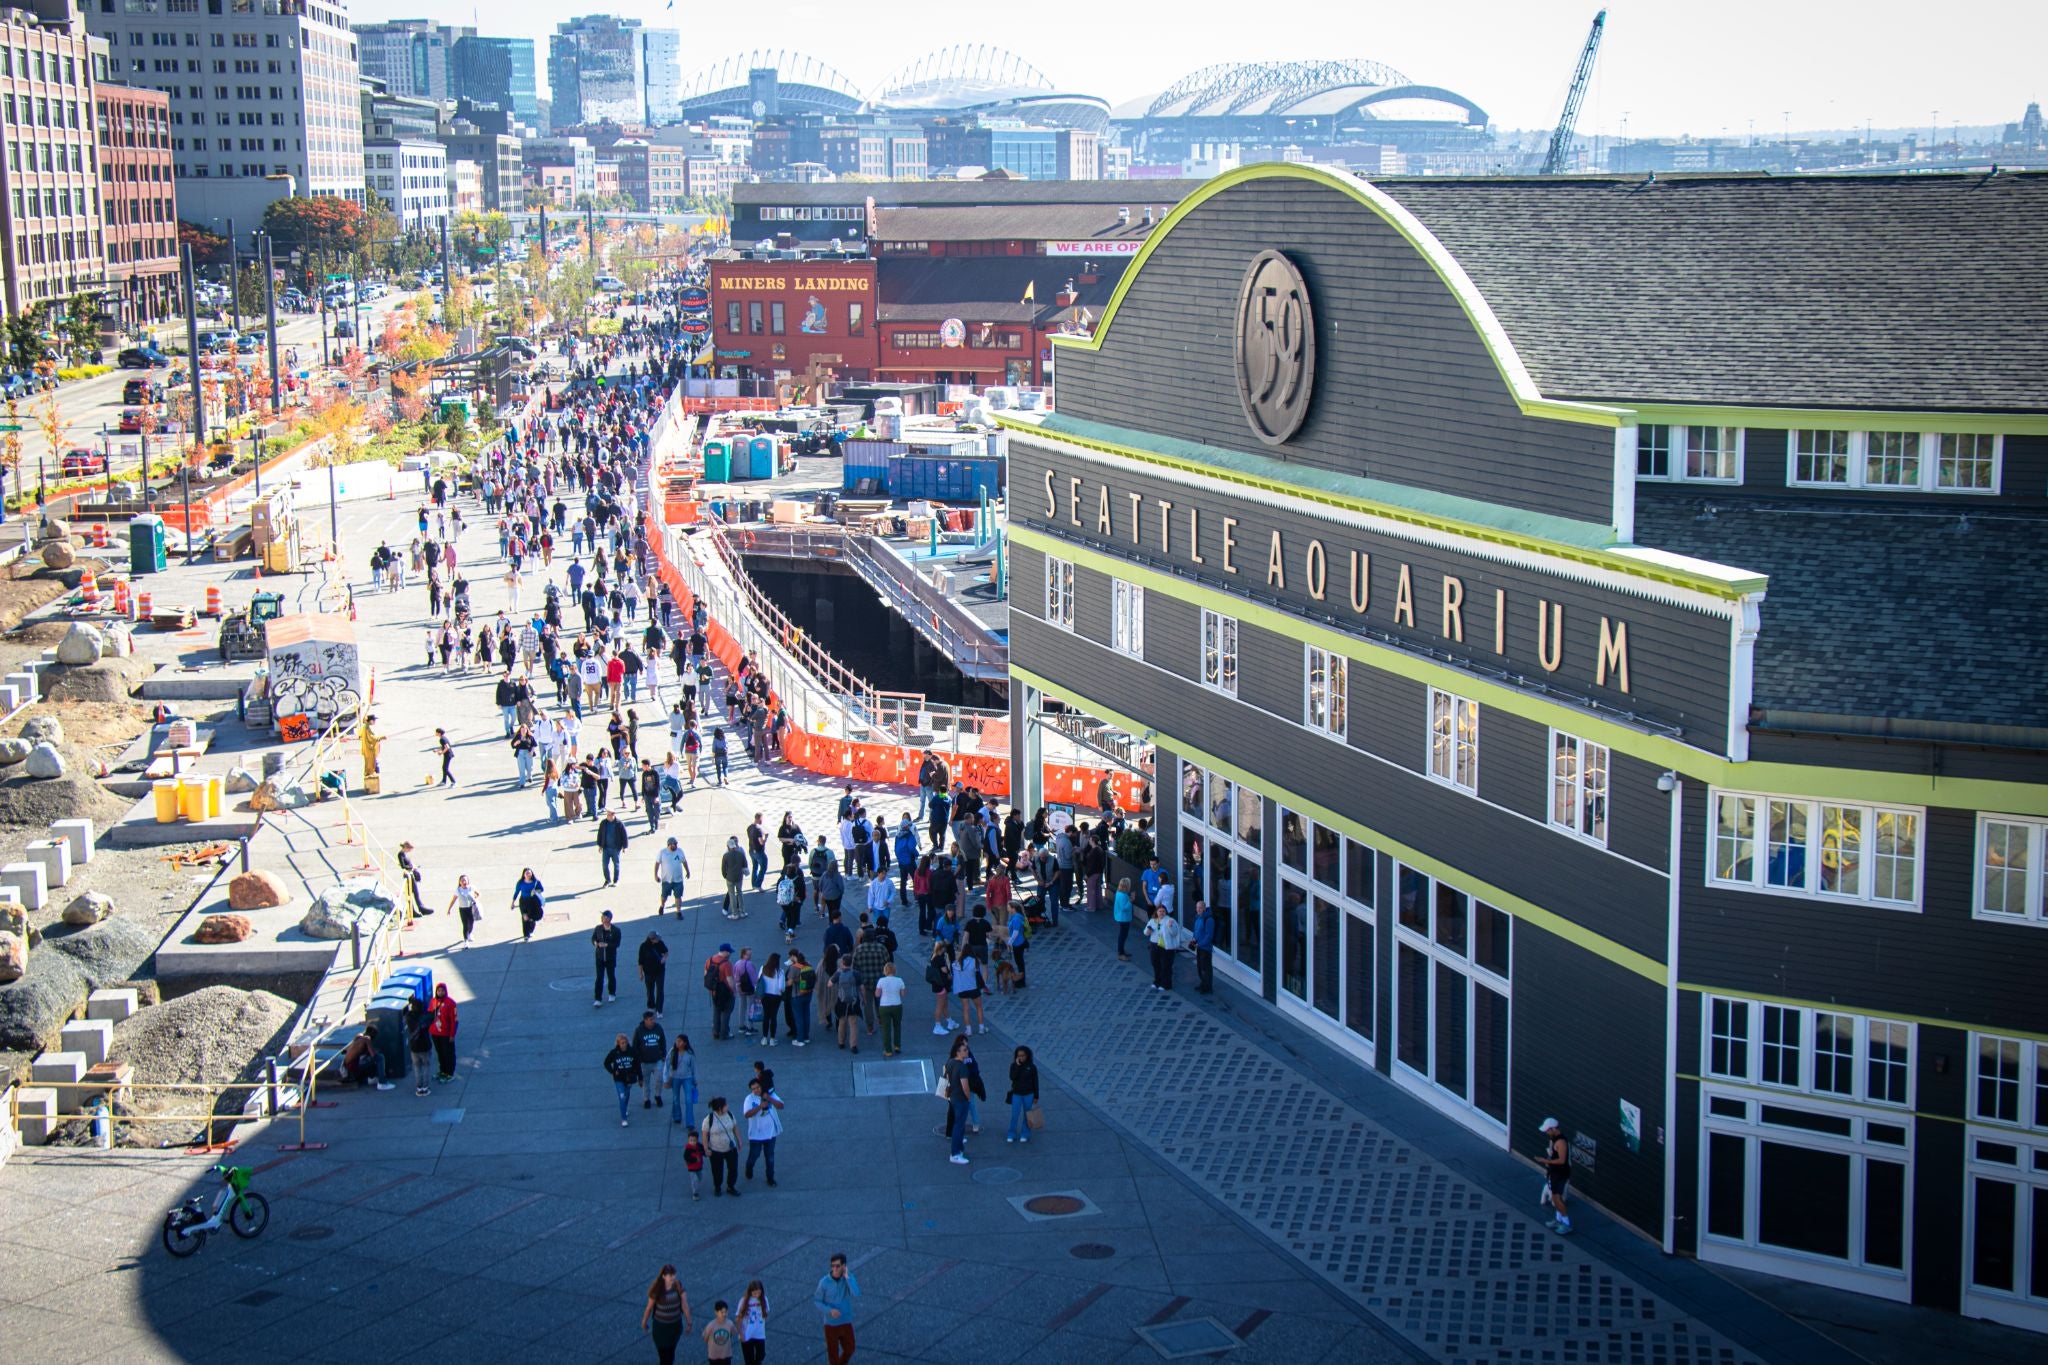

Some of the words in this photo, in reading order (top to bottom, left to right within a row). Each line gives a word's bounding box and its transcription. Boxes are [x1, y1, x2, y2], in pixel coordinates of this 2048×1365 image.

[1056, 243, 1080, 252] WE
[1083, 243, 1113, 252] ARE
[1117, 243, 1144, 252] OP
[720, 277, 786, 290] MINERS
[794, 277, 869, 291] LANDING
[1045, 469, 1239, 574] SEATTLE
[1267, 530, 1630, 694] AQUARIUM
